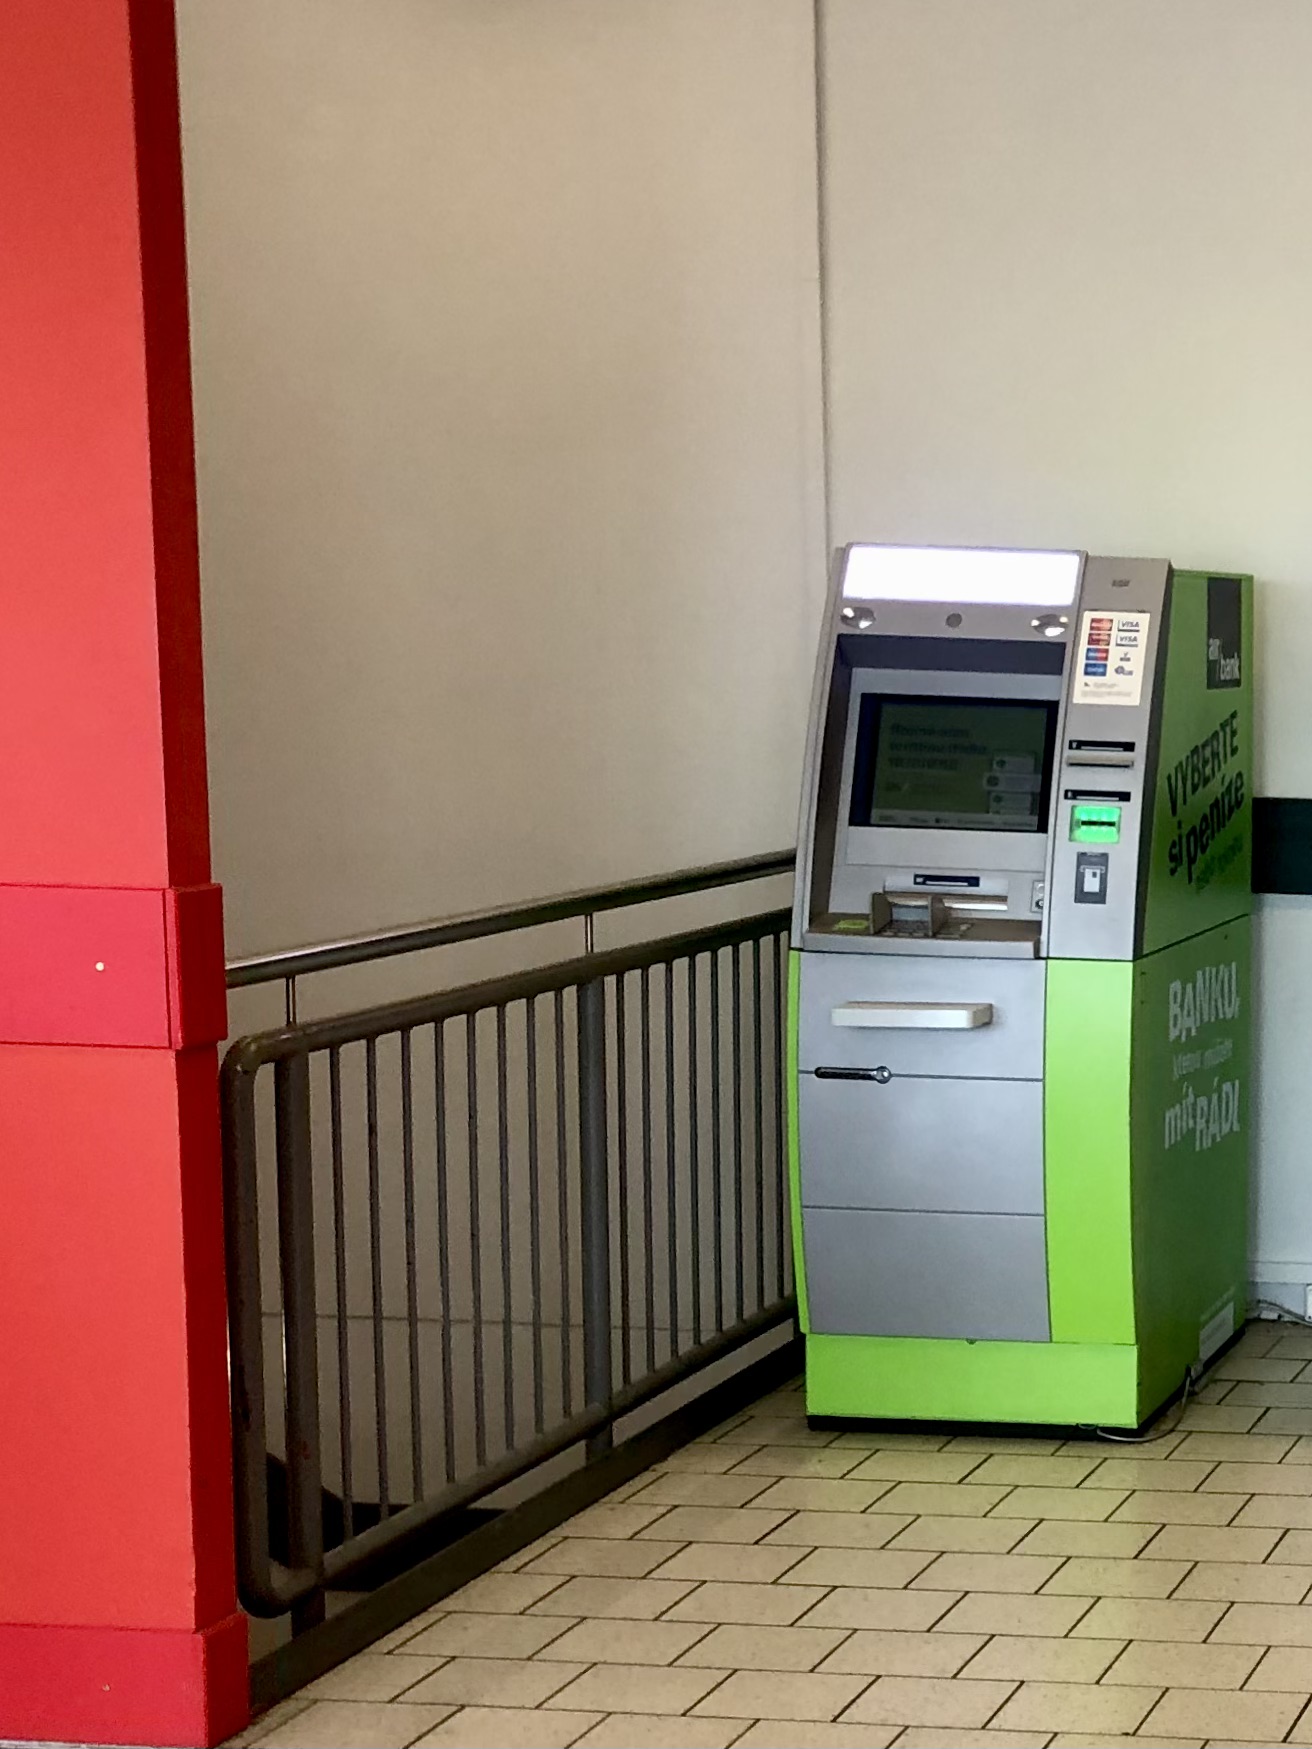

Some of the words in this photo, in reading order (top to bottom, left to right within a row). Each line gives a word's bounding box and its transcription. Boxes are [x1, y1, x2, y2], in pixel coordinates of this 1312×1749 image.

[1166, 709, 1239, 818] VYBERTE
[1168, 820, 1183, 877] si
[1186, 770, 1245, 885] peníze
